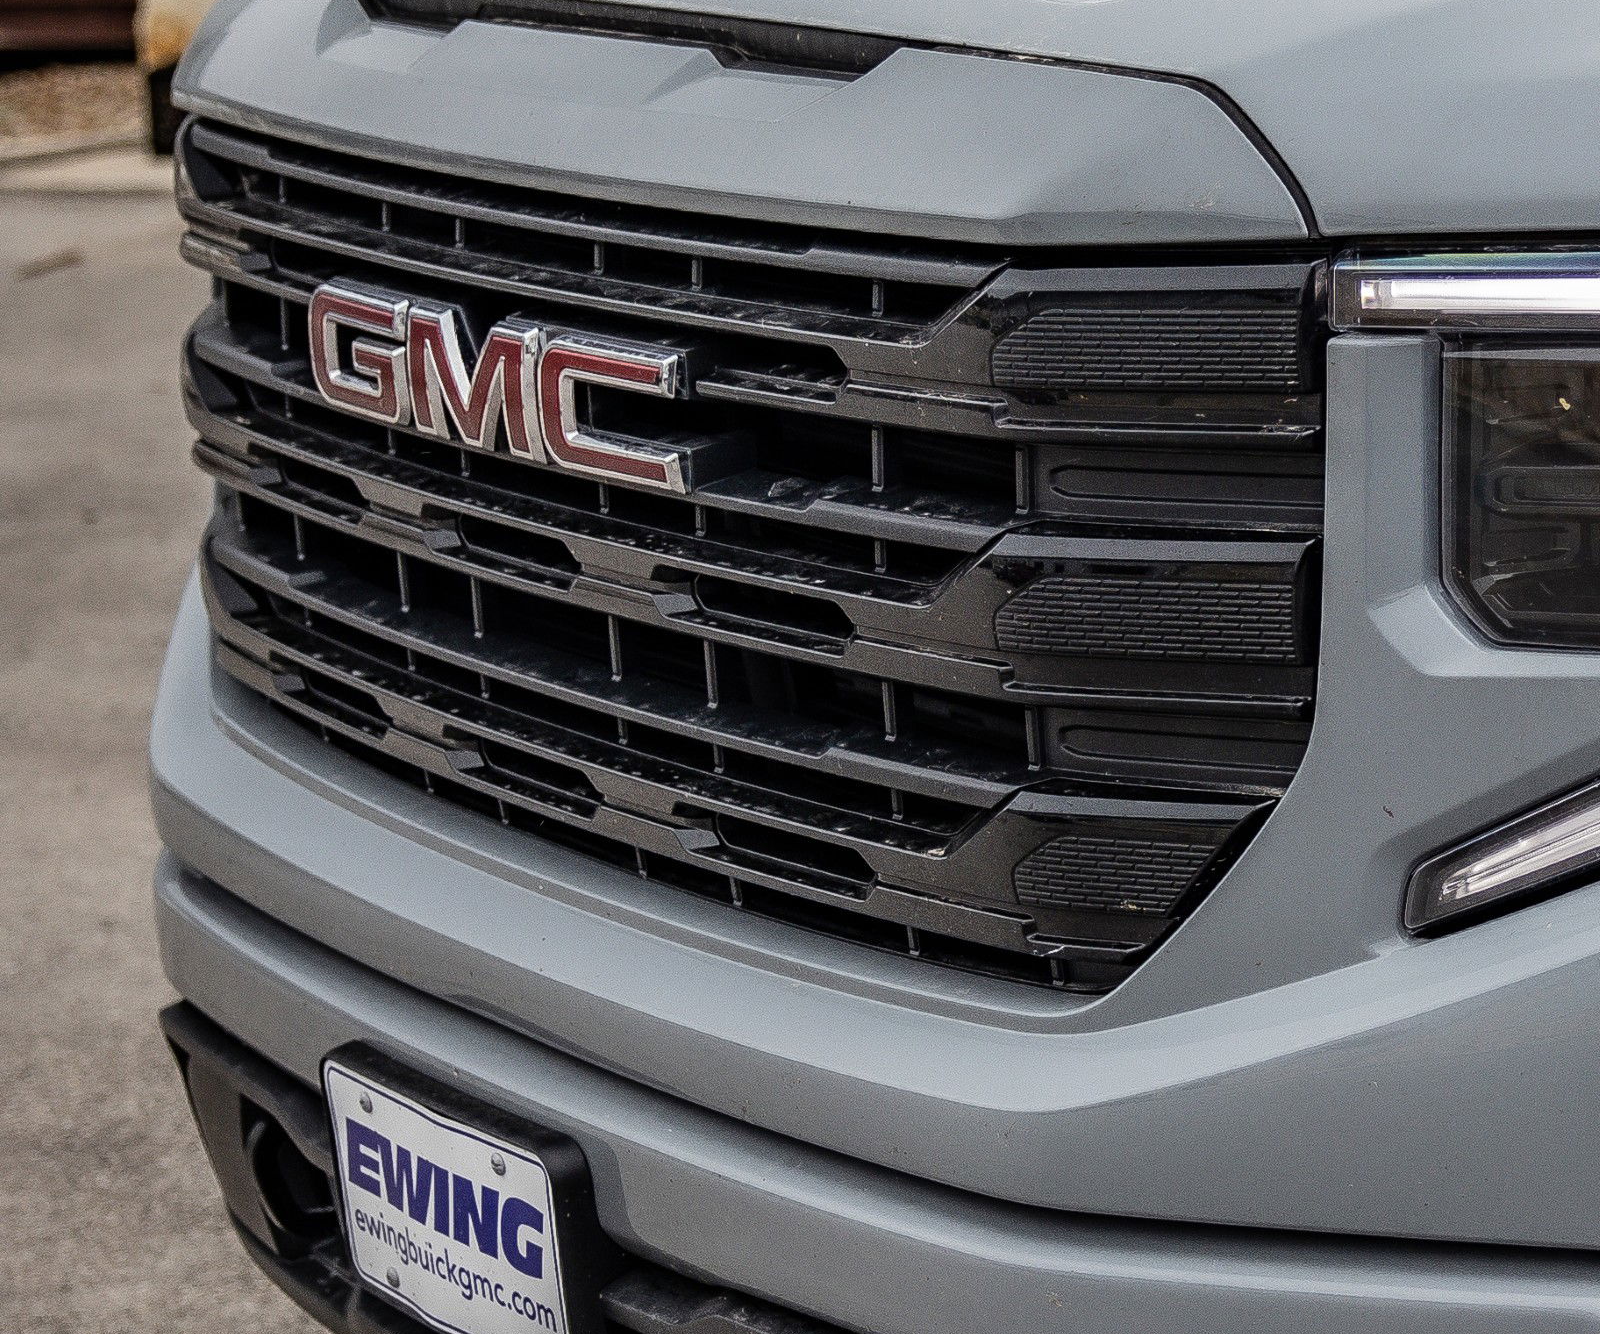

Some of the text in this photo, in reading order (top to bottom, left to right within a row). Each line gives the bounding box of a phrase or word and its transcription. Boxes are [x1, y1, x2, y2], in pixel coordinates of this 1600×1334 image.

[307, 279, 692, 494] GMC
[345, 1116, 544, 1279] EWING
[355, 1207, 557, 1333] ewingbuickgmc.com
